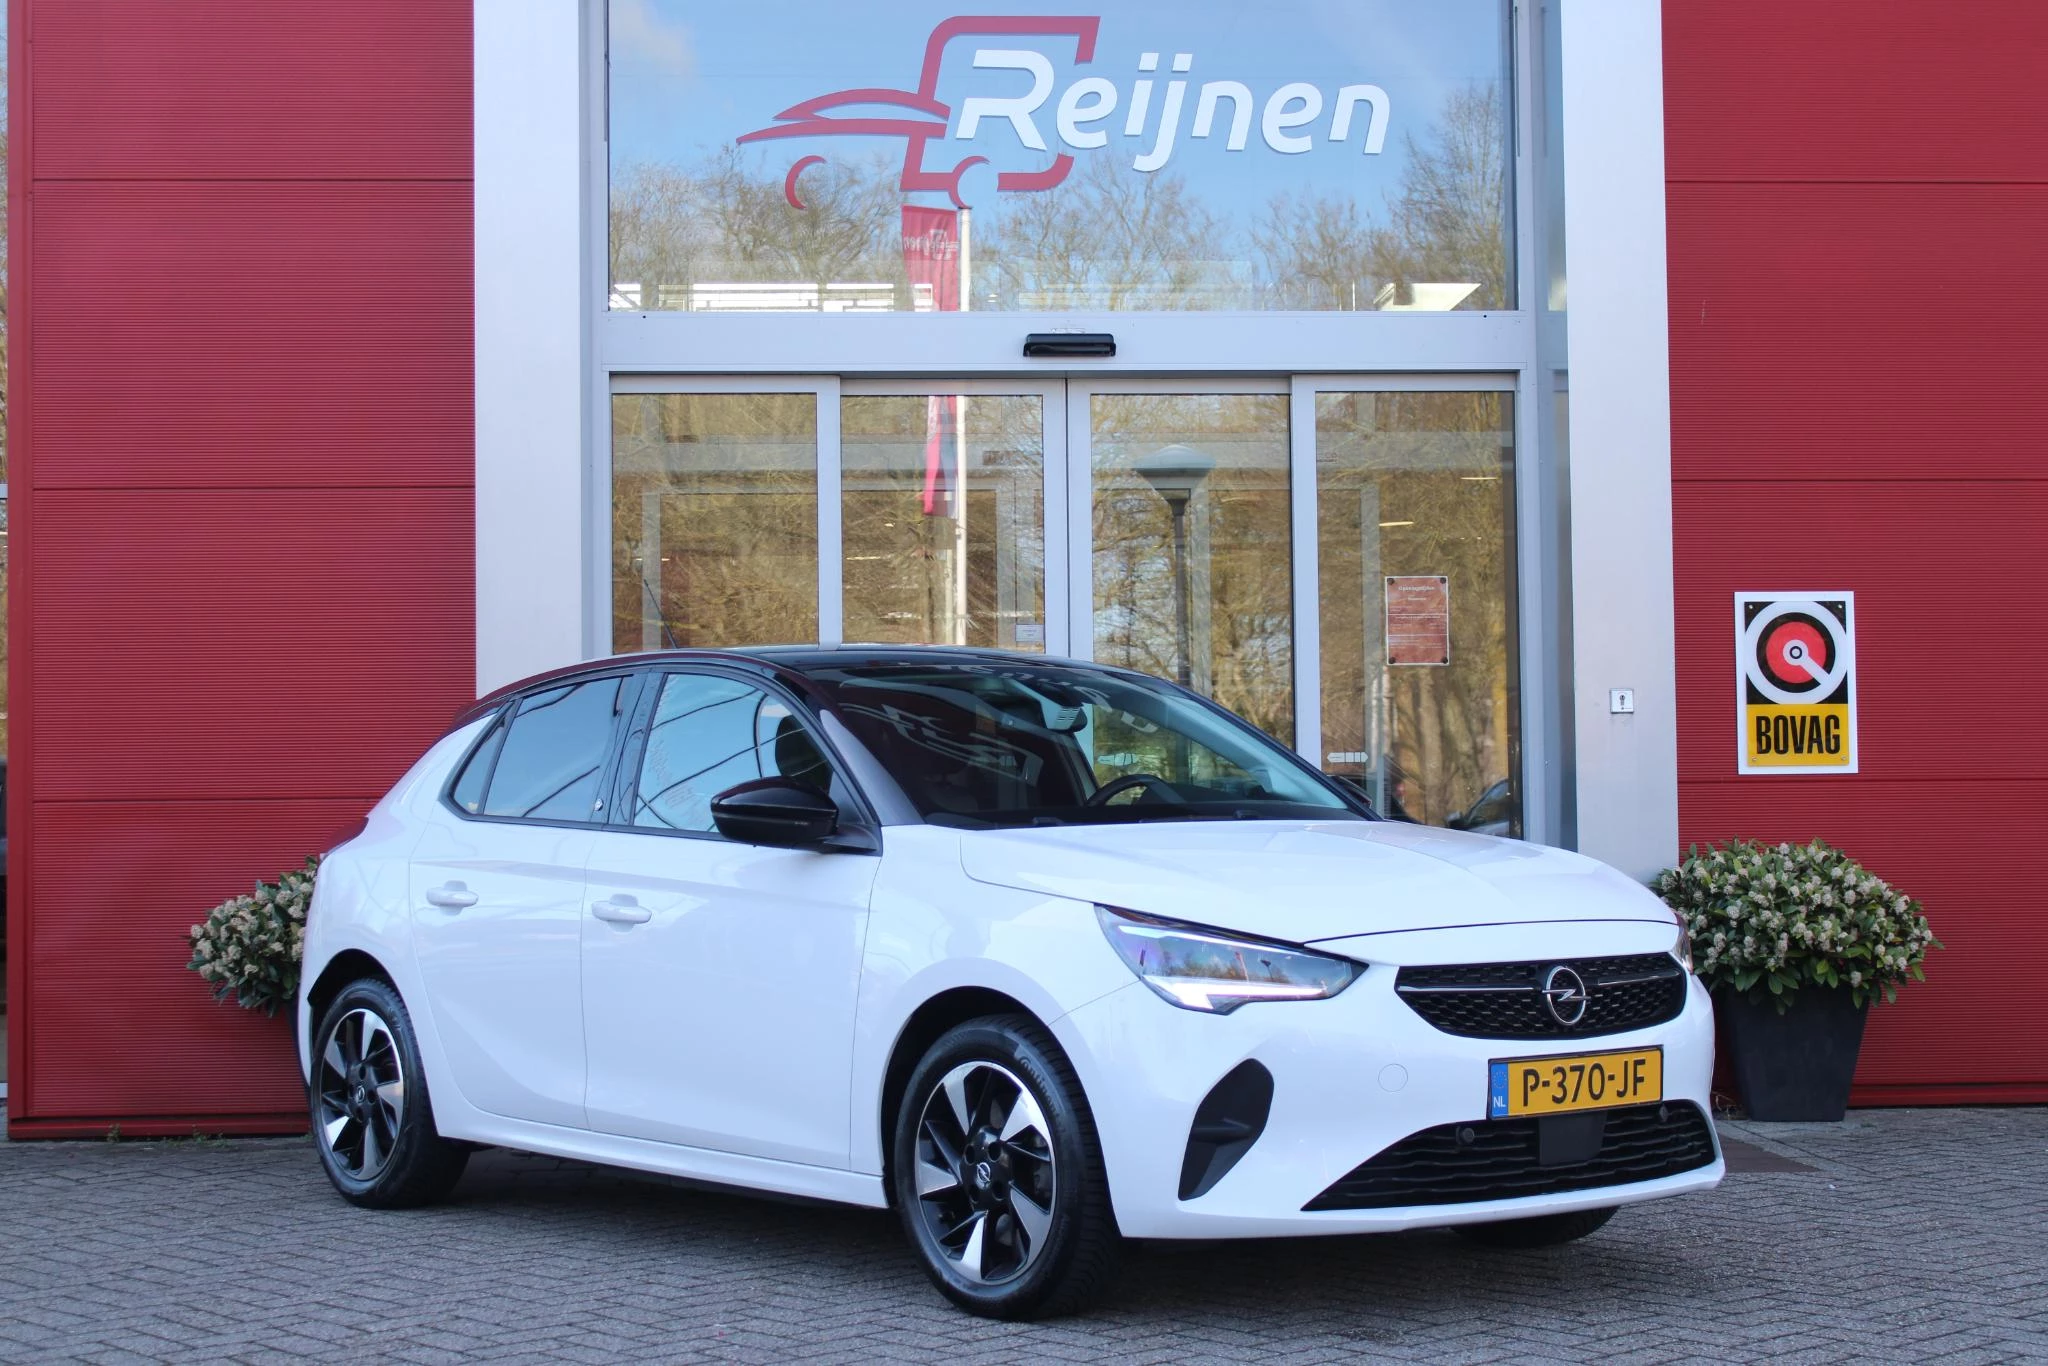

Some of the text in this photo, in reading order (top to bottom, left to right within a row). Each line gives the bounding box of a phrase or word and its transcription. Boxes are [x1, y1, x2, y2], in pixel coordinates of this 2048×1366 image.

[956, 49, 1391, 172] Reijnen
[1755, 714, 1840, 755] BOVAG
[1493, 1095, 1506, 1109] NL
[1522, 1058, 1647, 1107] P-370-JF
